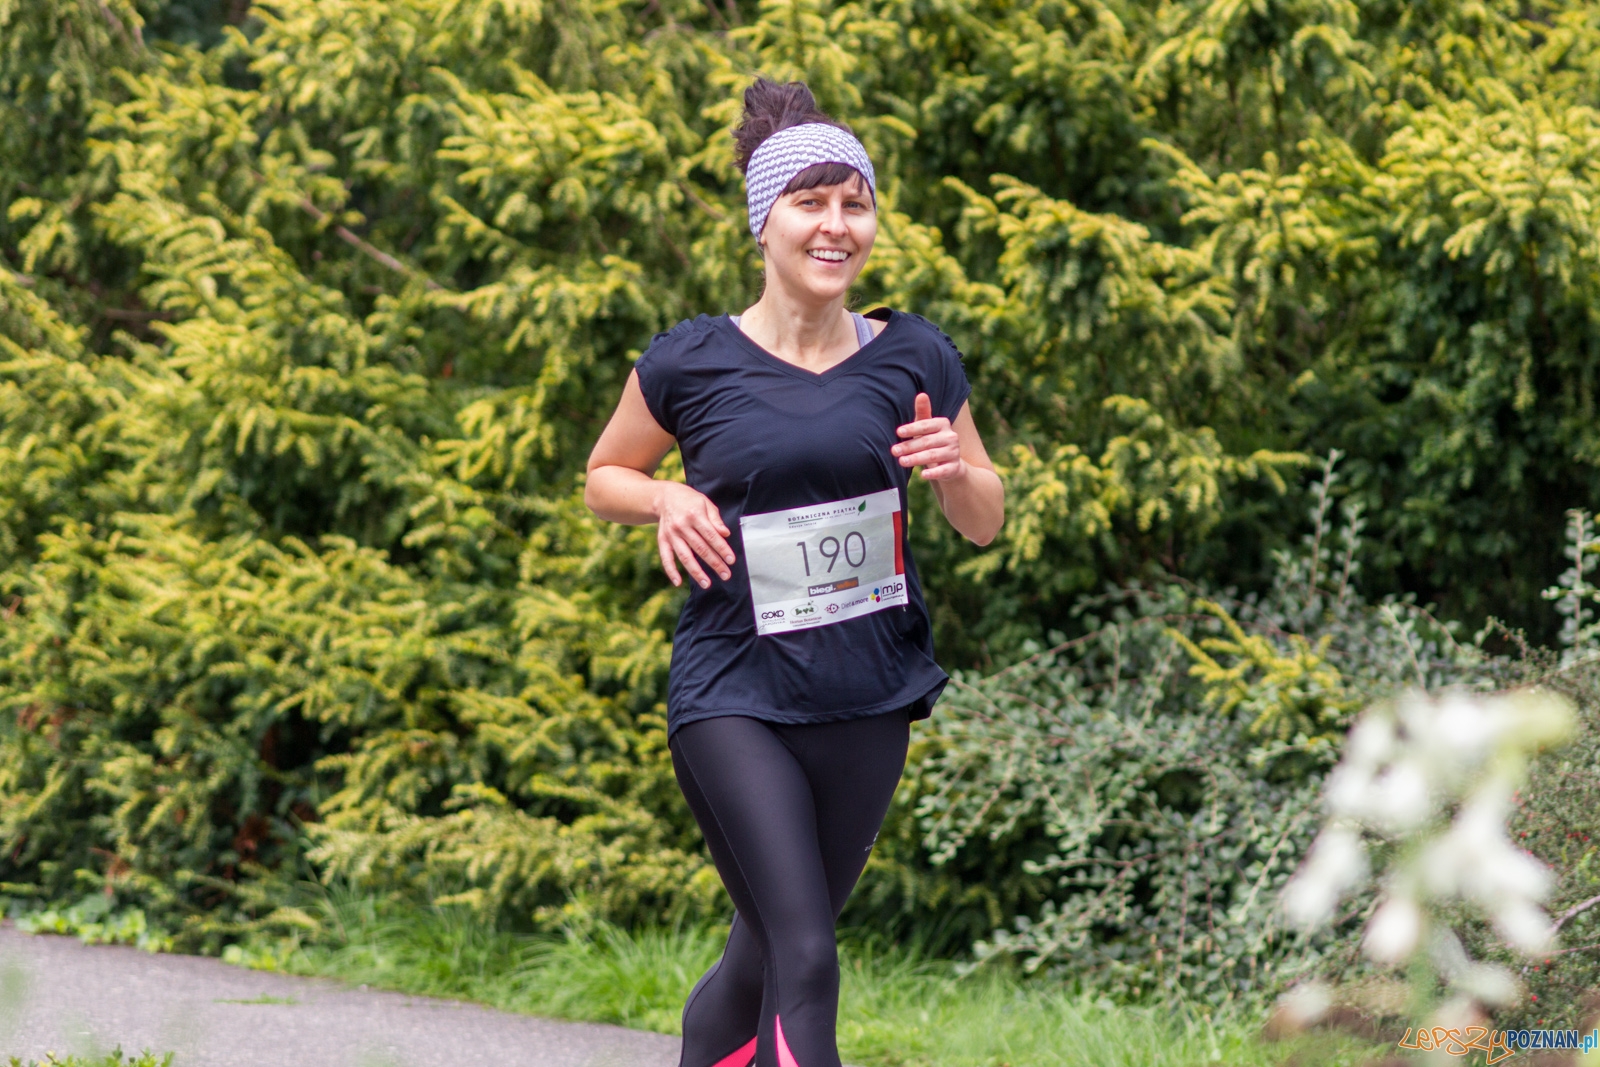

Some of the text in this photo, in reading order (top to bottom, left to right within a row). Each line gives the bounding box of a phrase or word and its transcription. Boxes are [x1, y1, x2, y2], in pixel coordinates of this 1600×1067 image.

[787, 511, 831, 522] BOTANICZNA
[833, 506, 856, 515] PIĄTKA
[796, 531, 866, 577] 190
[882, 582, 904, 595] mjp
